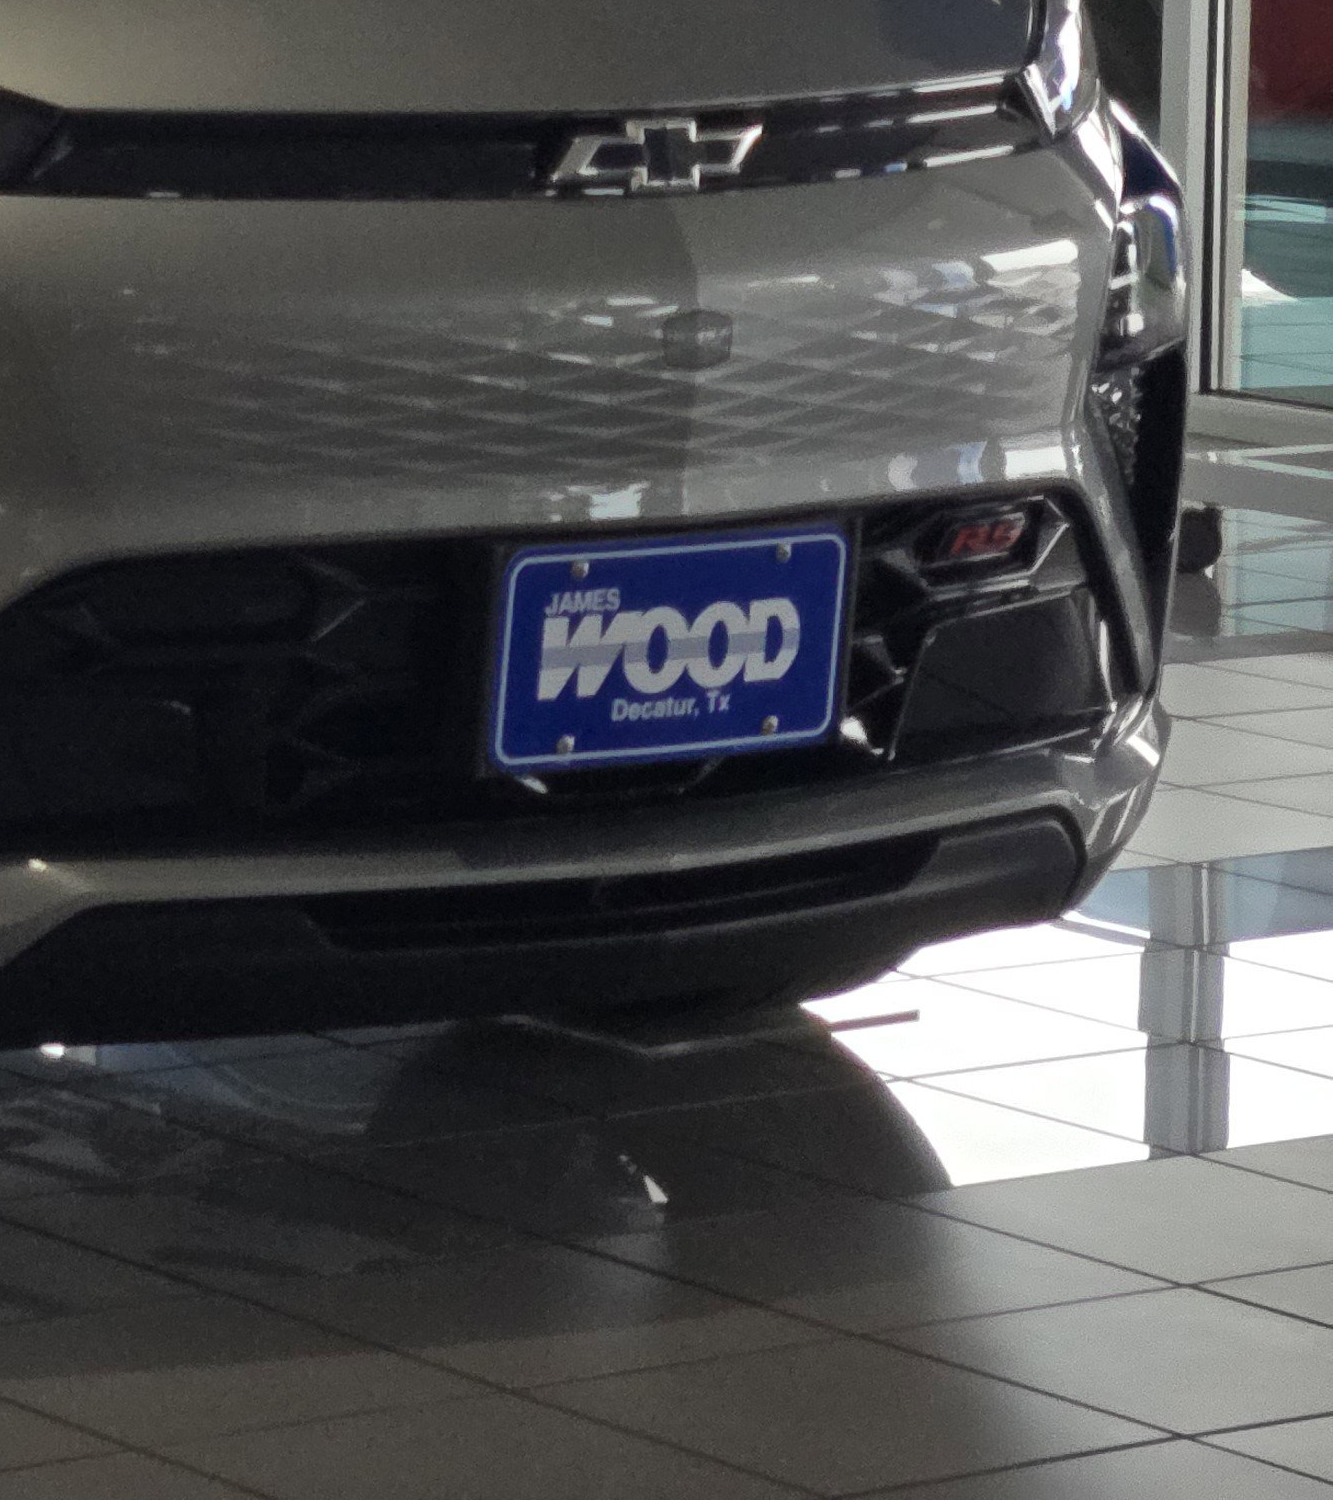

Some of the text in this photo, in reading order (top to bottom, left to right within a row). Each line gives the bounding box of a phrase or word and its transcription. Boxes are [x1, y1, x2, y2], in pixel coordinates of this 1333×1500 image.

[545, 587, 621, 615] JAMES
[537, 597, 801, 701] WOOD
[611, 689, 731, 722] Decatur, Tx
